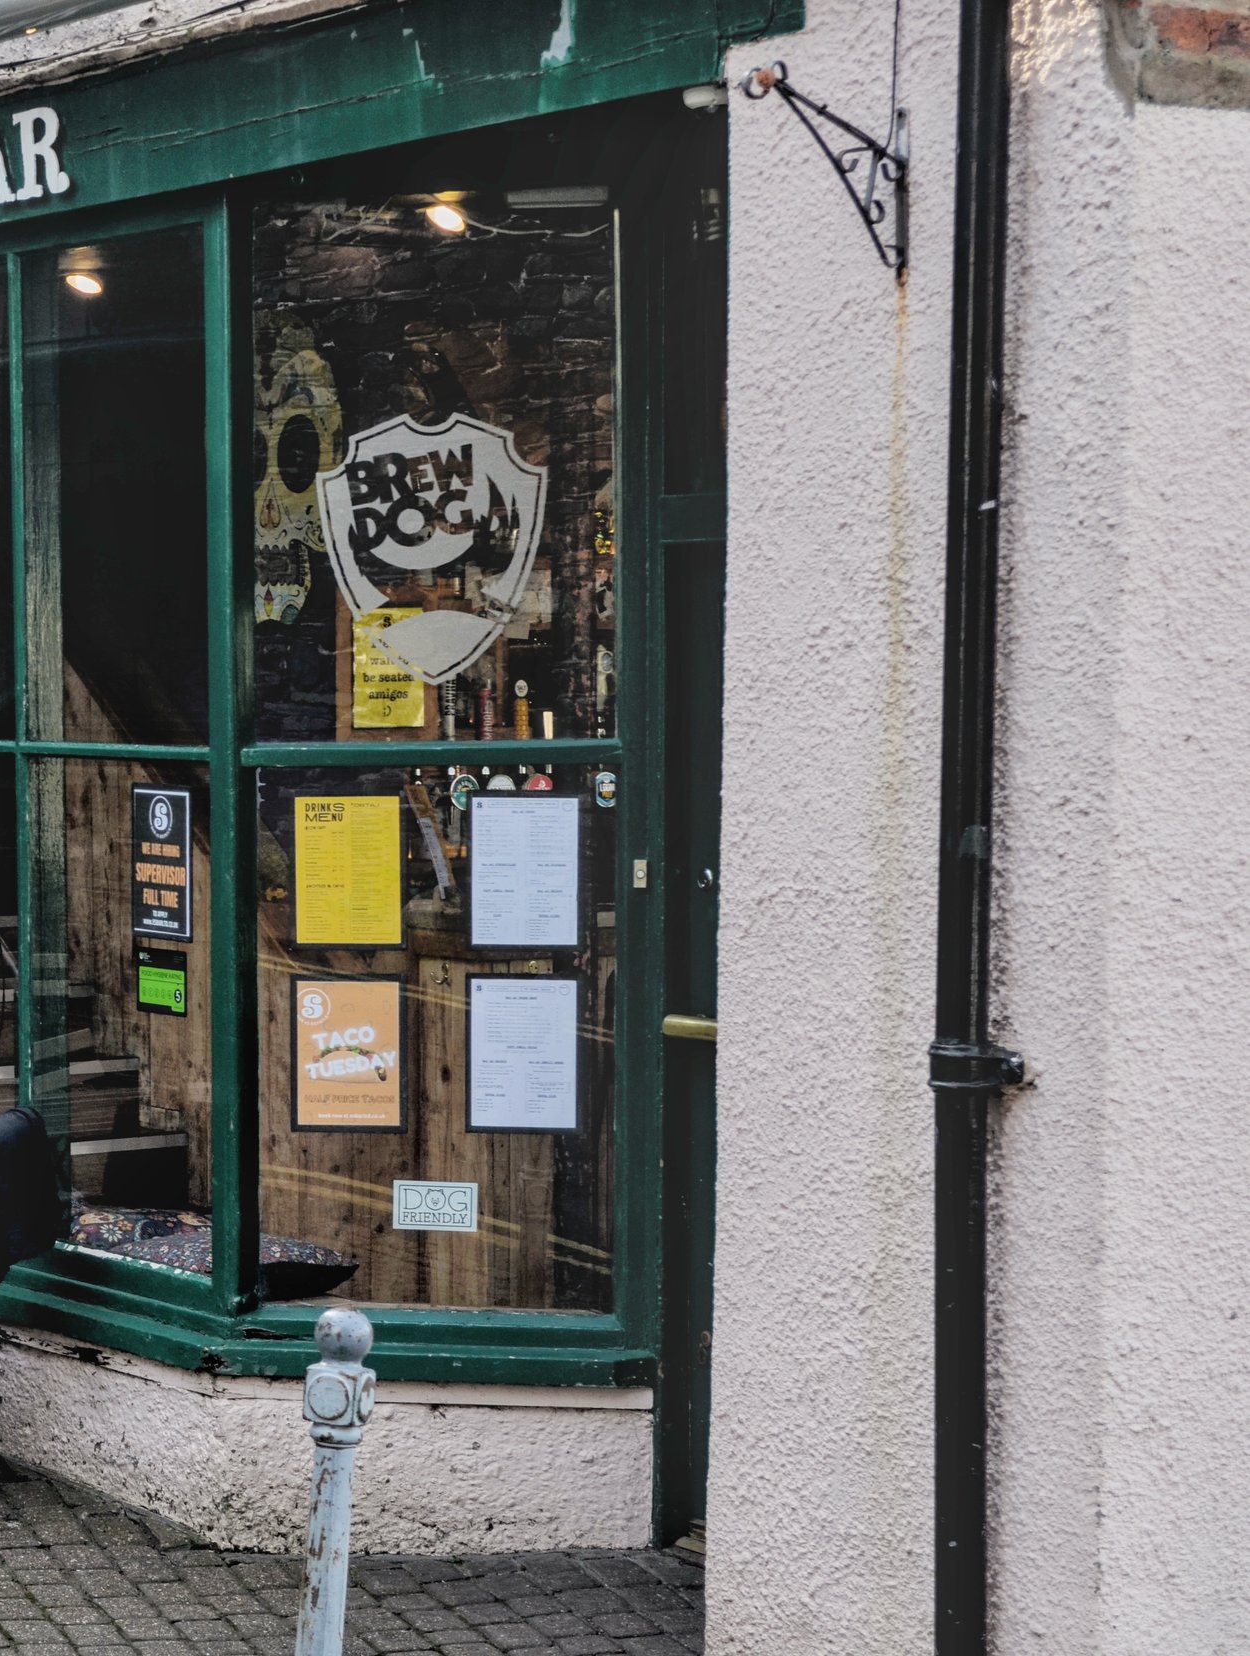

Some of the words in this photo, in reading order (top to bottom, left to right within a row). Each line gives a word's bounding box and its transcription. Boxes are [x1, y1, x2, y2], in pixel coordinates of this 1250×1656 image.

[345, 443, 474, 506] BREW
[348, 489, 474, 550] DOG
[363, 672, 375, 682] be
[368, 689, 408, 701] amigos
[305, 802, 345, 812] DRINKS
[305, 813, 343, 822] MENU
[135, 862, 186, 886] SUPERVISOR
[143, 888, 159, 906] FULL
[161, 890, 178, 908] TIME
[175, 990, 181, 1002] 5
[311, 1025, 376, 1050] TACO
[305, 1051, 398, 1080] TUESDAY
[403, 1188, 468, 1212] DOG
[402, 1211, 468, 1224] FRIENDLY
